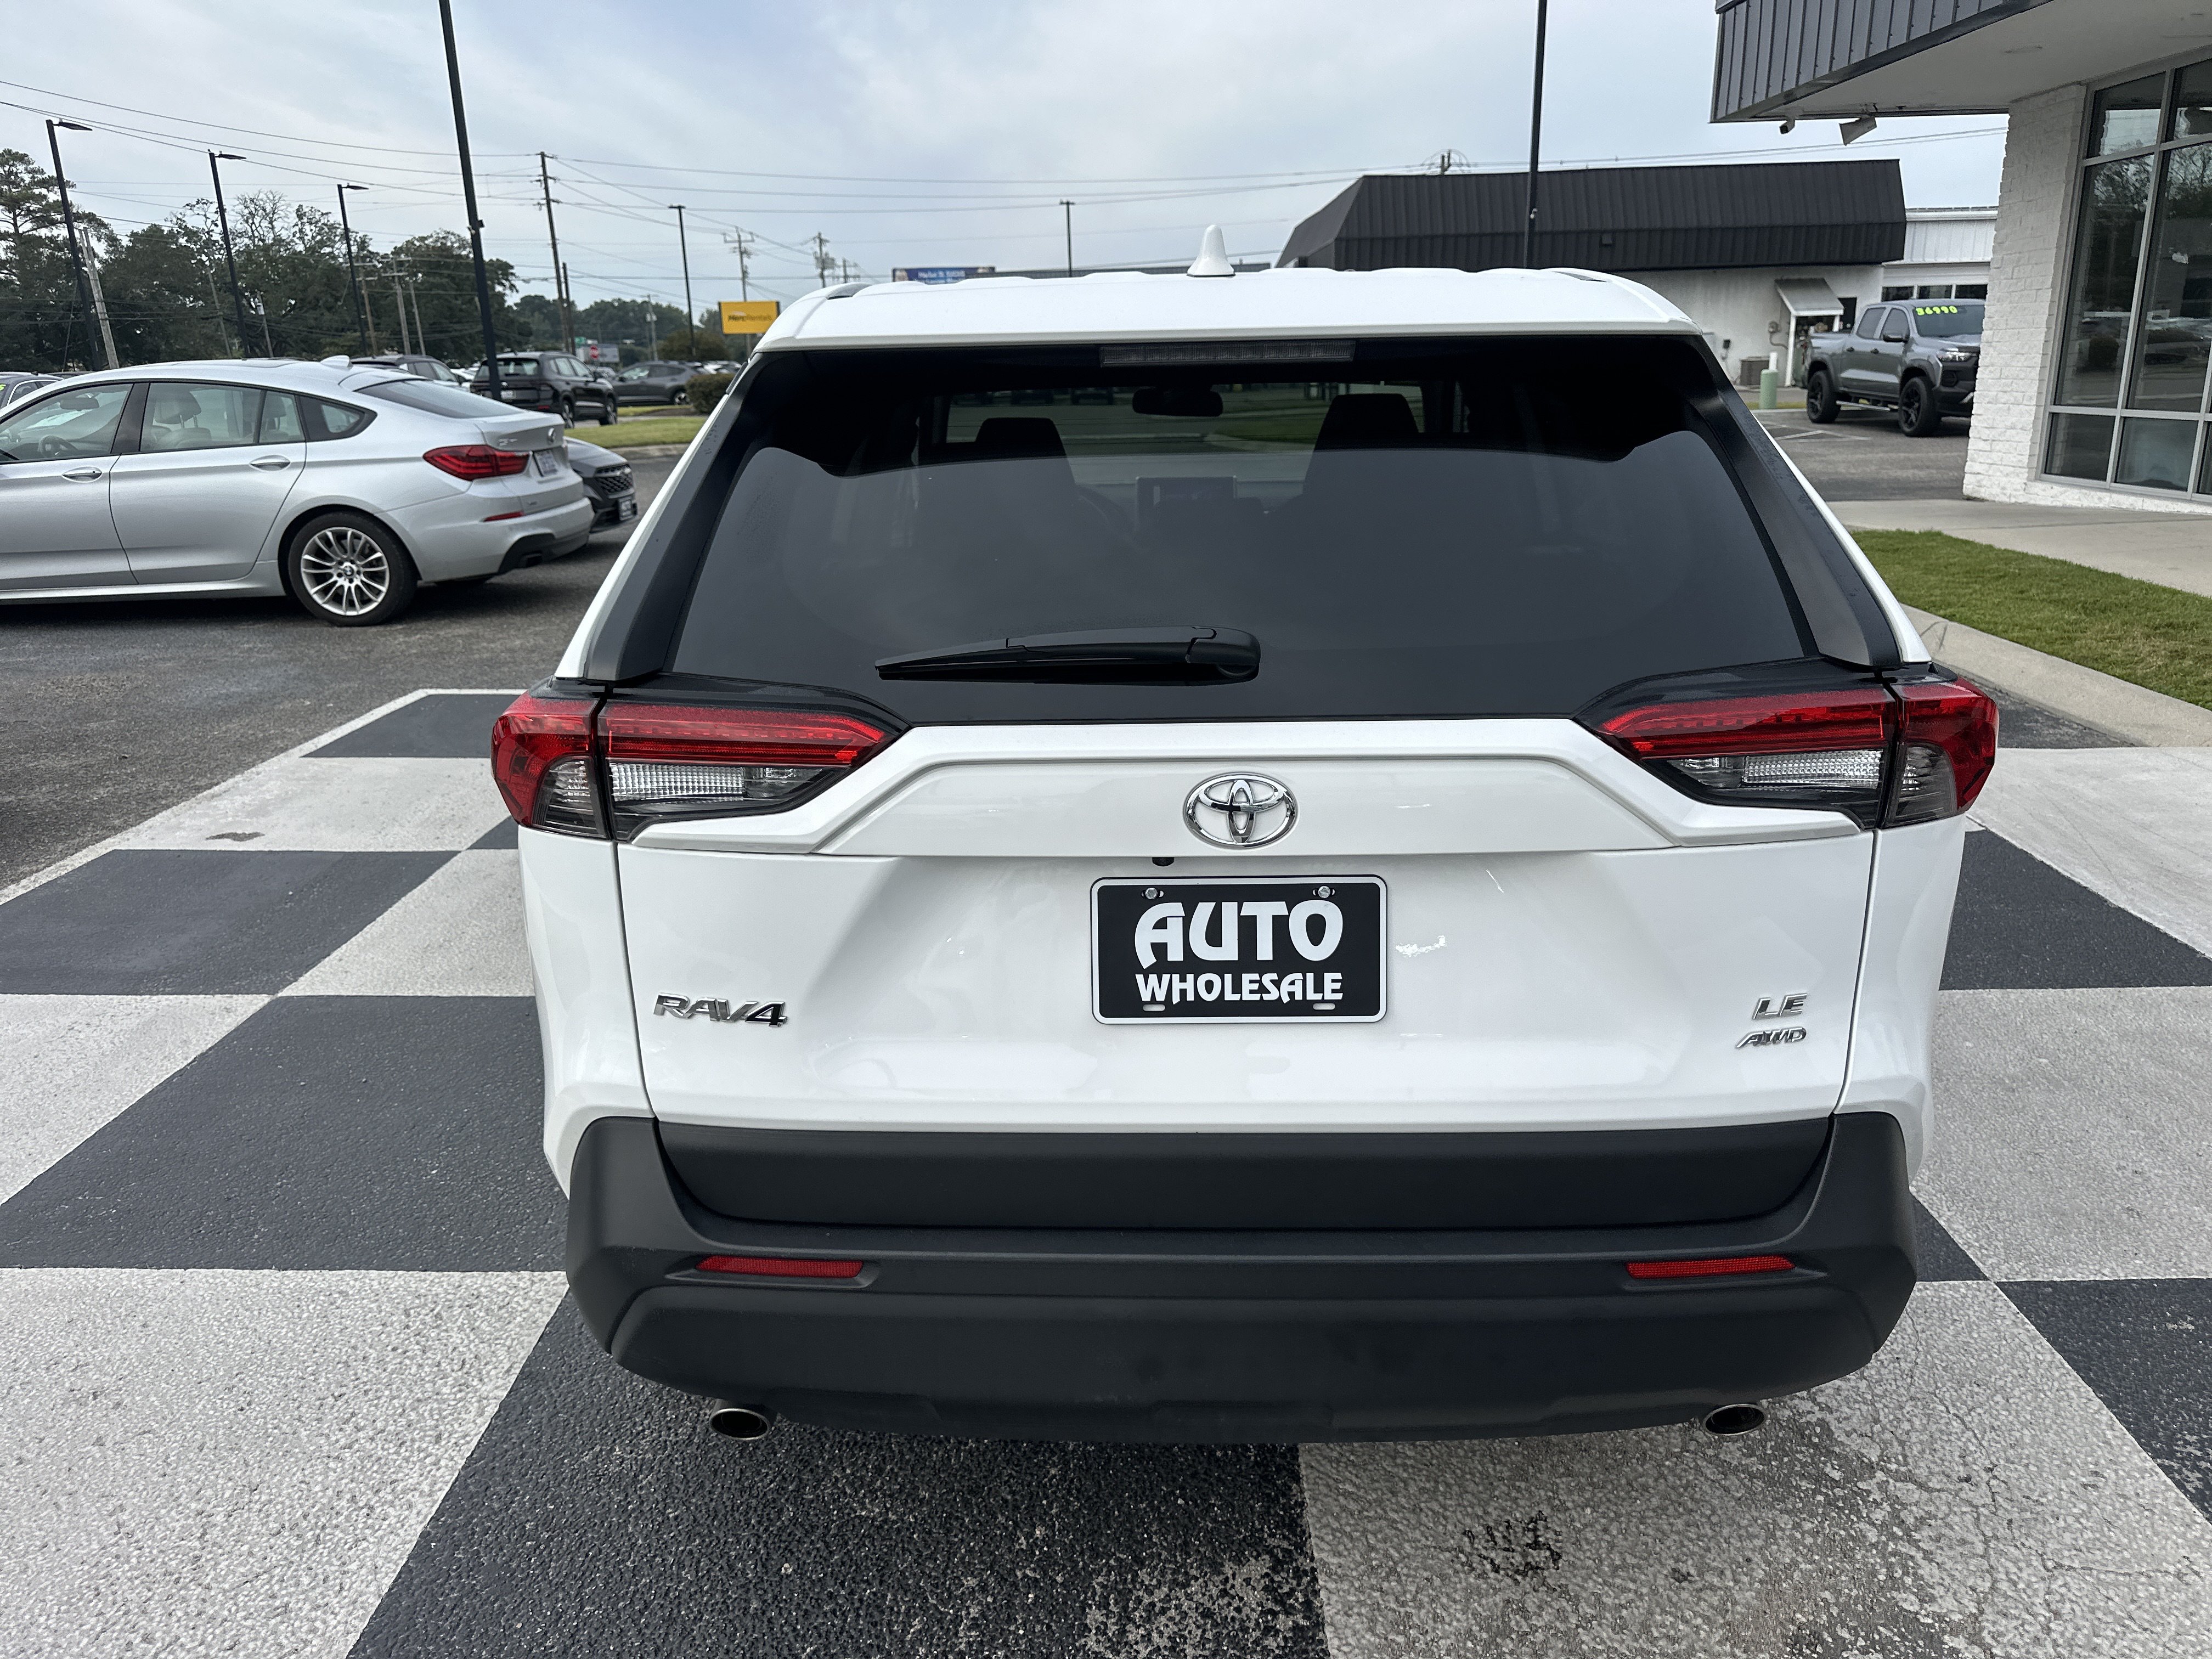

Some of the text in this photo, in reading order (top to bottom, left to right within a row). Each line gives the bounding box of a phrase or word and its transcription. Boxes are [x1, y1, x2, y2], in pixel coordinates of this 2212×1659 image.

[1915, 305, 1958, 316] 36990
[1134, 899, 1344, 969] AUTO
[1135, 972, 1344, 1005] WHOLESALE
[653, 991, 788, 1027] RAV4
[1751, 992, 1808, 1020] LE
[1734, 1026, 1807, 1049] AWD
